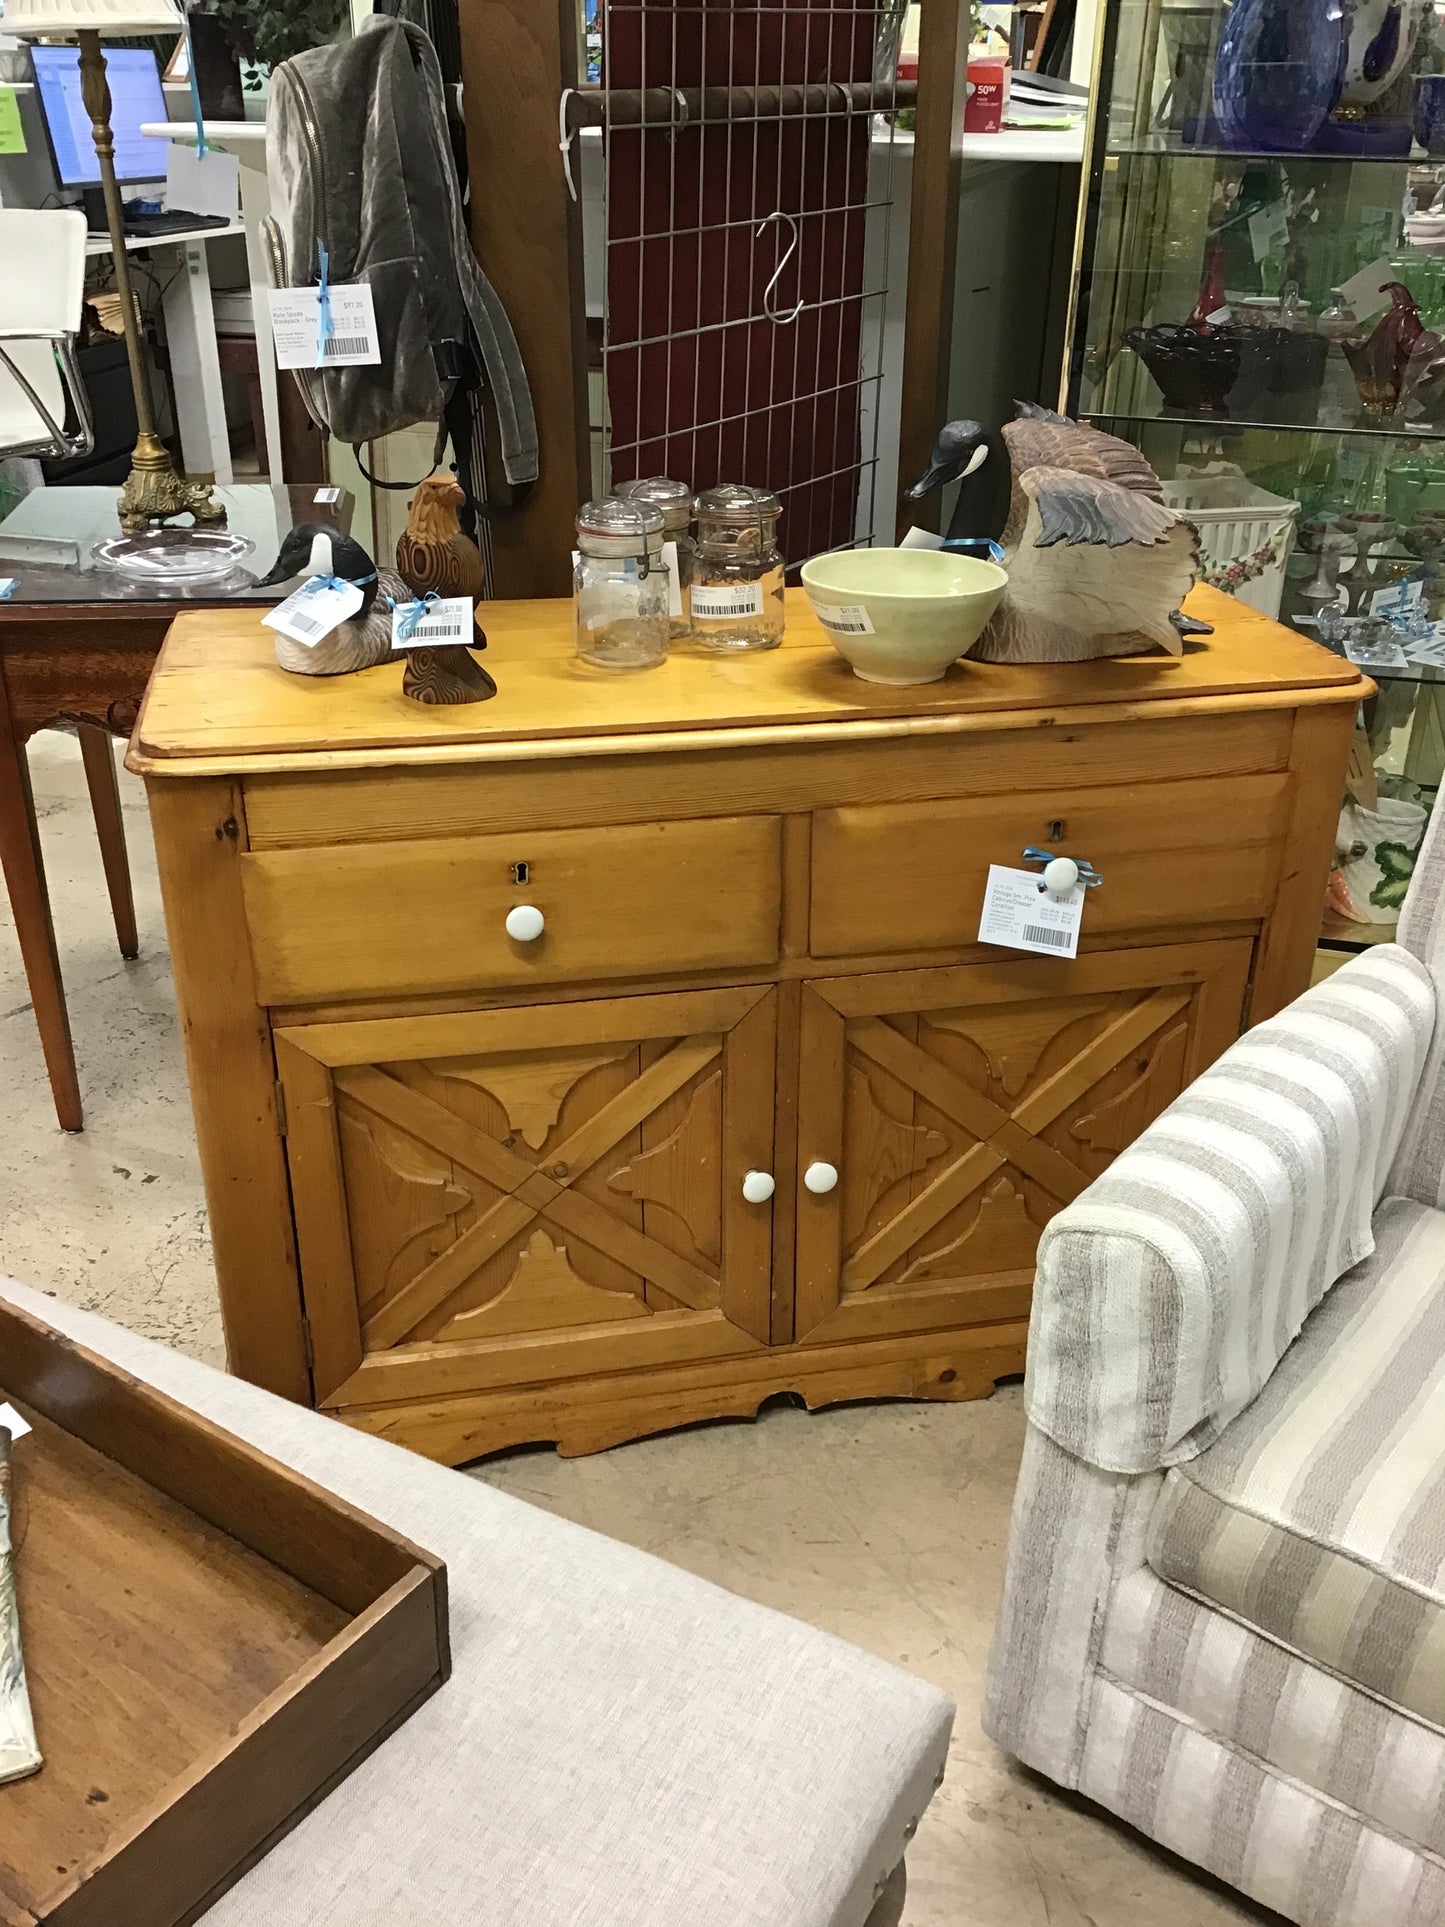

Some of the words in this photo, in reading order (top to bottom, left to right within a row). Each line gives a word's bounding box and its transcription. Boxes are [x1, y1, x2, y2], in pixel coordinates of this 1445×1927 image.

[977, 85, 997, 95] 50W
[445, 604, 463, 613] $21.00
[993, 889, 1012, 898] Vintage
